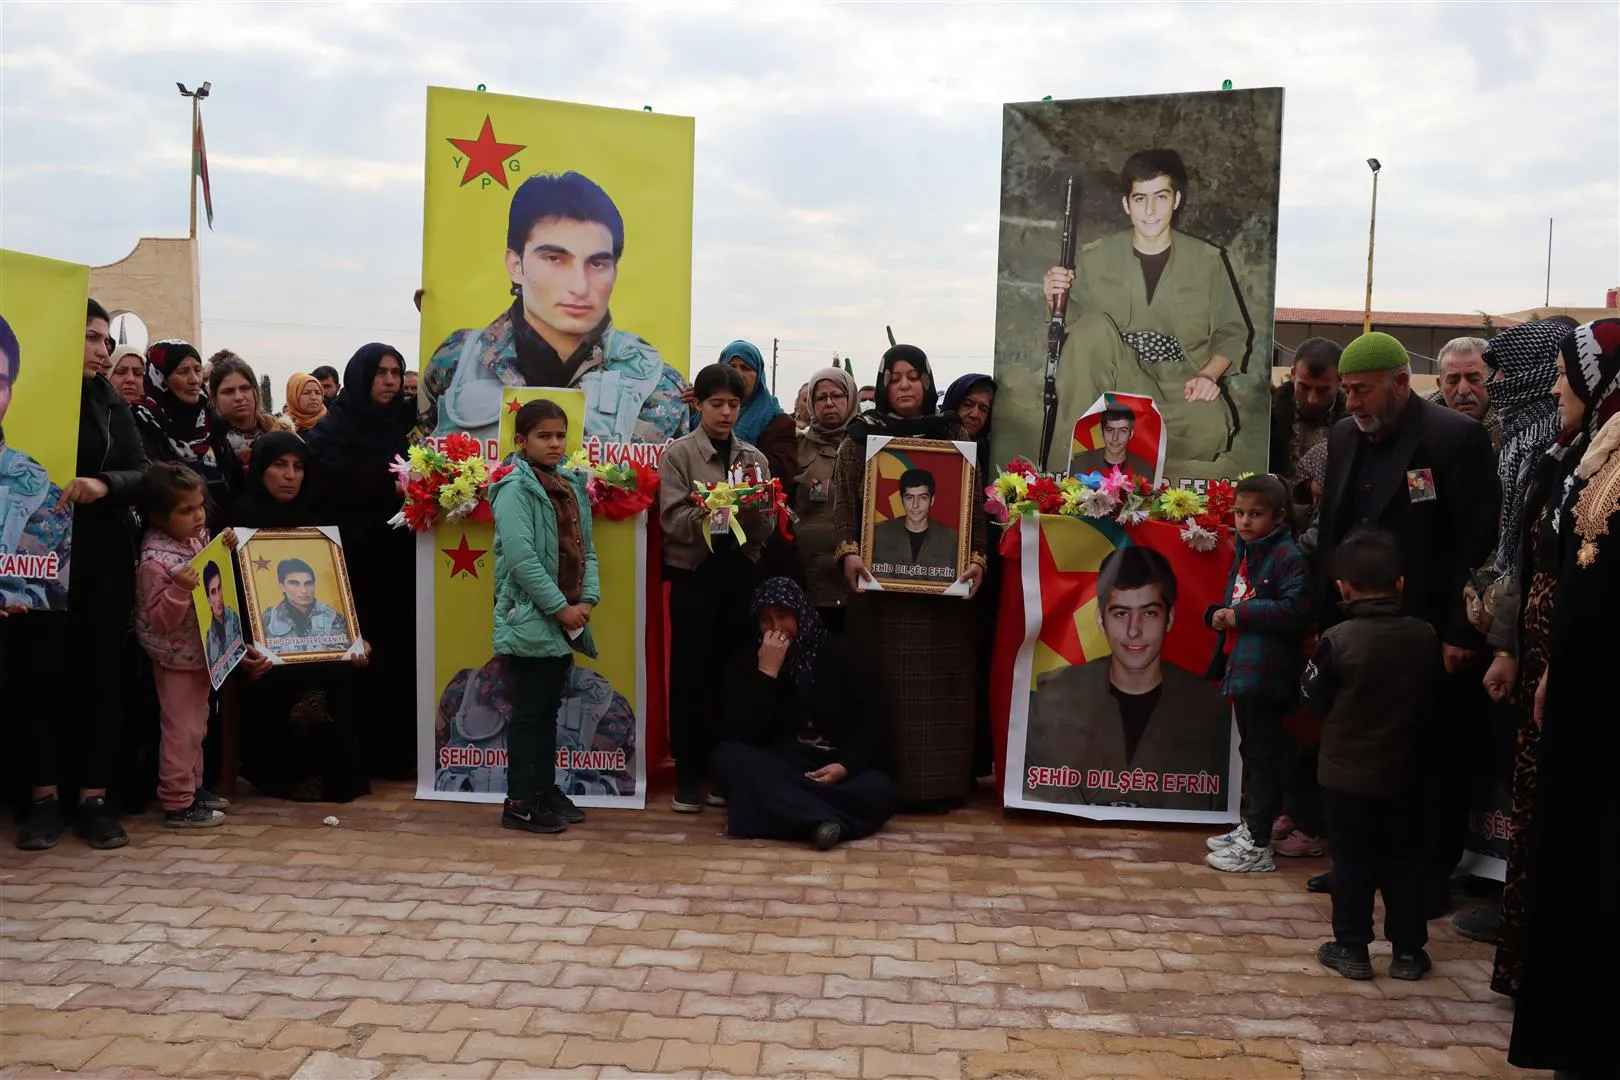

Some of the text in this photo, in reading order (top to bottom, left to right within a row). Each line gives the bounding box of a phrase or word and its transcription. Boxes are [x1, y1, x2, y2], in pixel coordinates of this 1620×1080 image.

[605, 438, 674, 468] KANIY
[440, 743, 484, 769] ŞEHÎD
[485, 748, 508, 768] DIY
[571, 748, 626, 771] KANIYÊ
[1028, 765, 1221, 794] ŞEHÎD DILŞÊR EFRÎN
